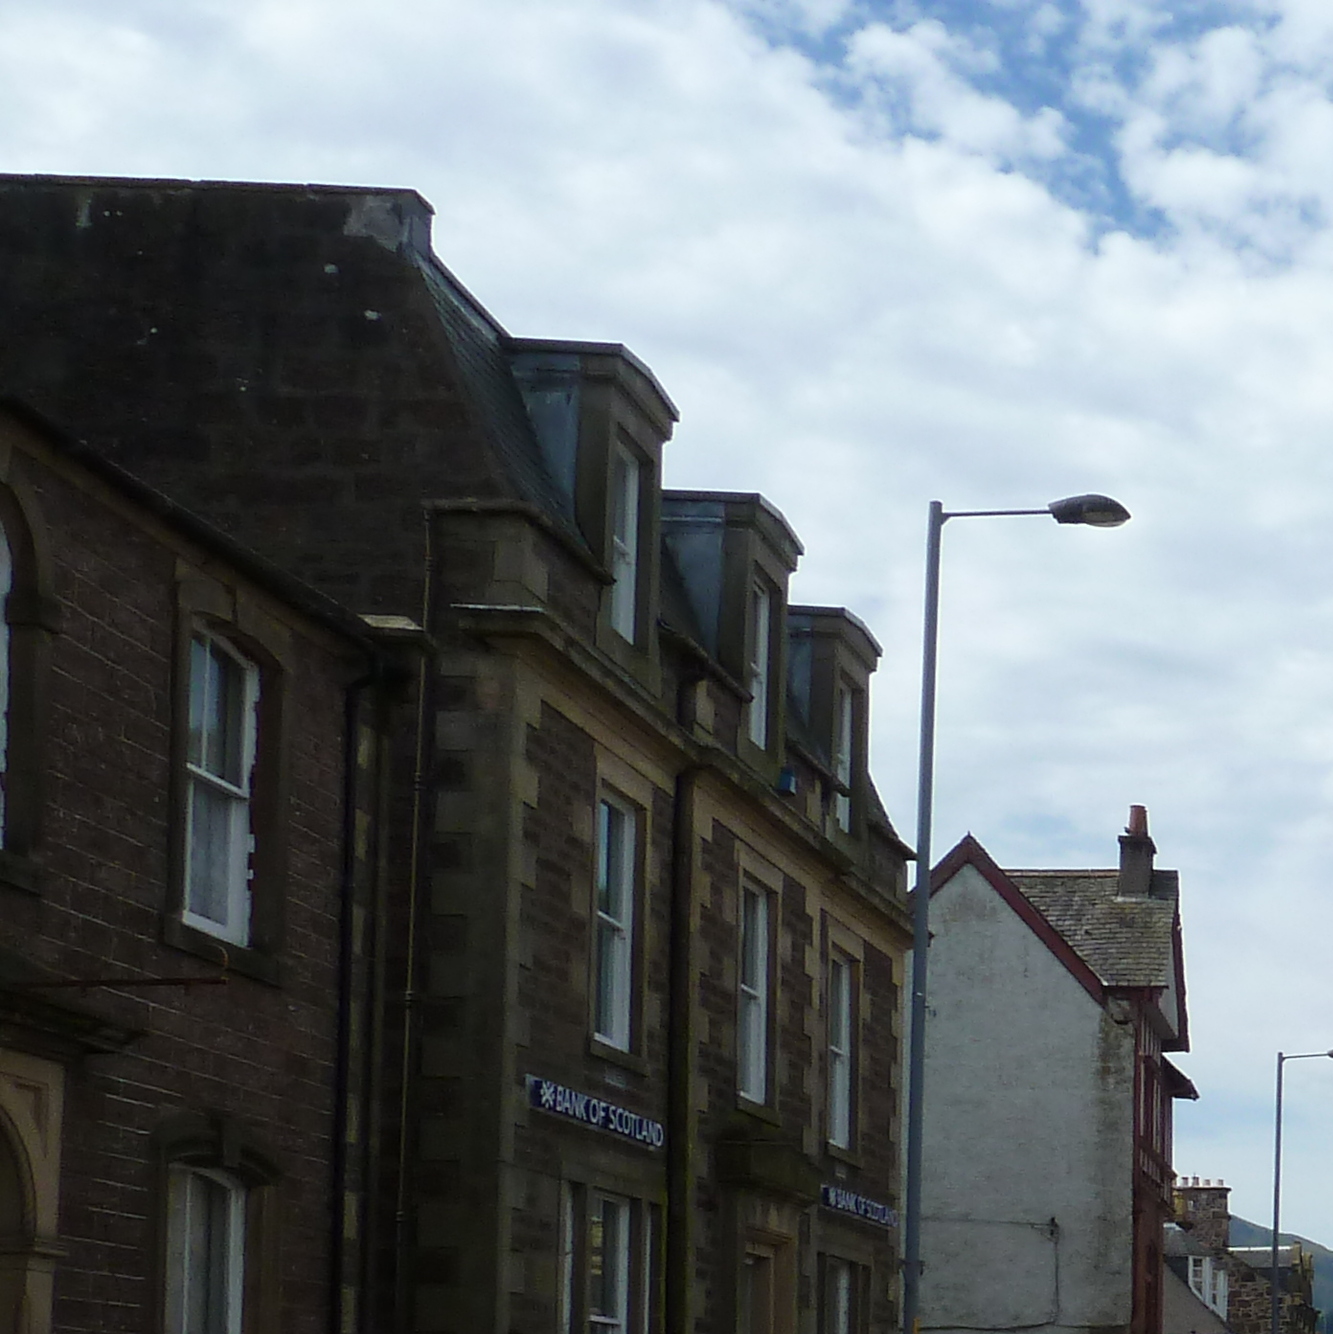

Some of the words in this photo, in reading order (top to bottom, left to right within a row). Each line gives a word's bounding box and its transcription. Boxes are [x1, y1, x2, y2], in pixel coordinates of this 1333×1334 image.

[556, 1086, 588, 1120] BANK
[589, 1099, 608, 1124] OF
[609, 1105, 664, 1147] SCOTLAND
[837, 1188, 858, 1213] BANK
